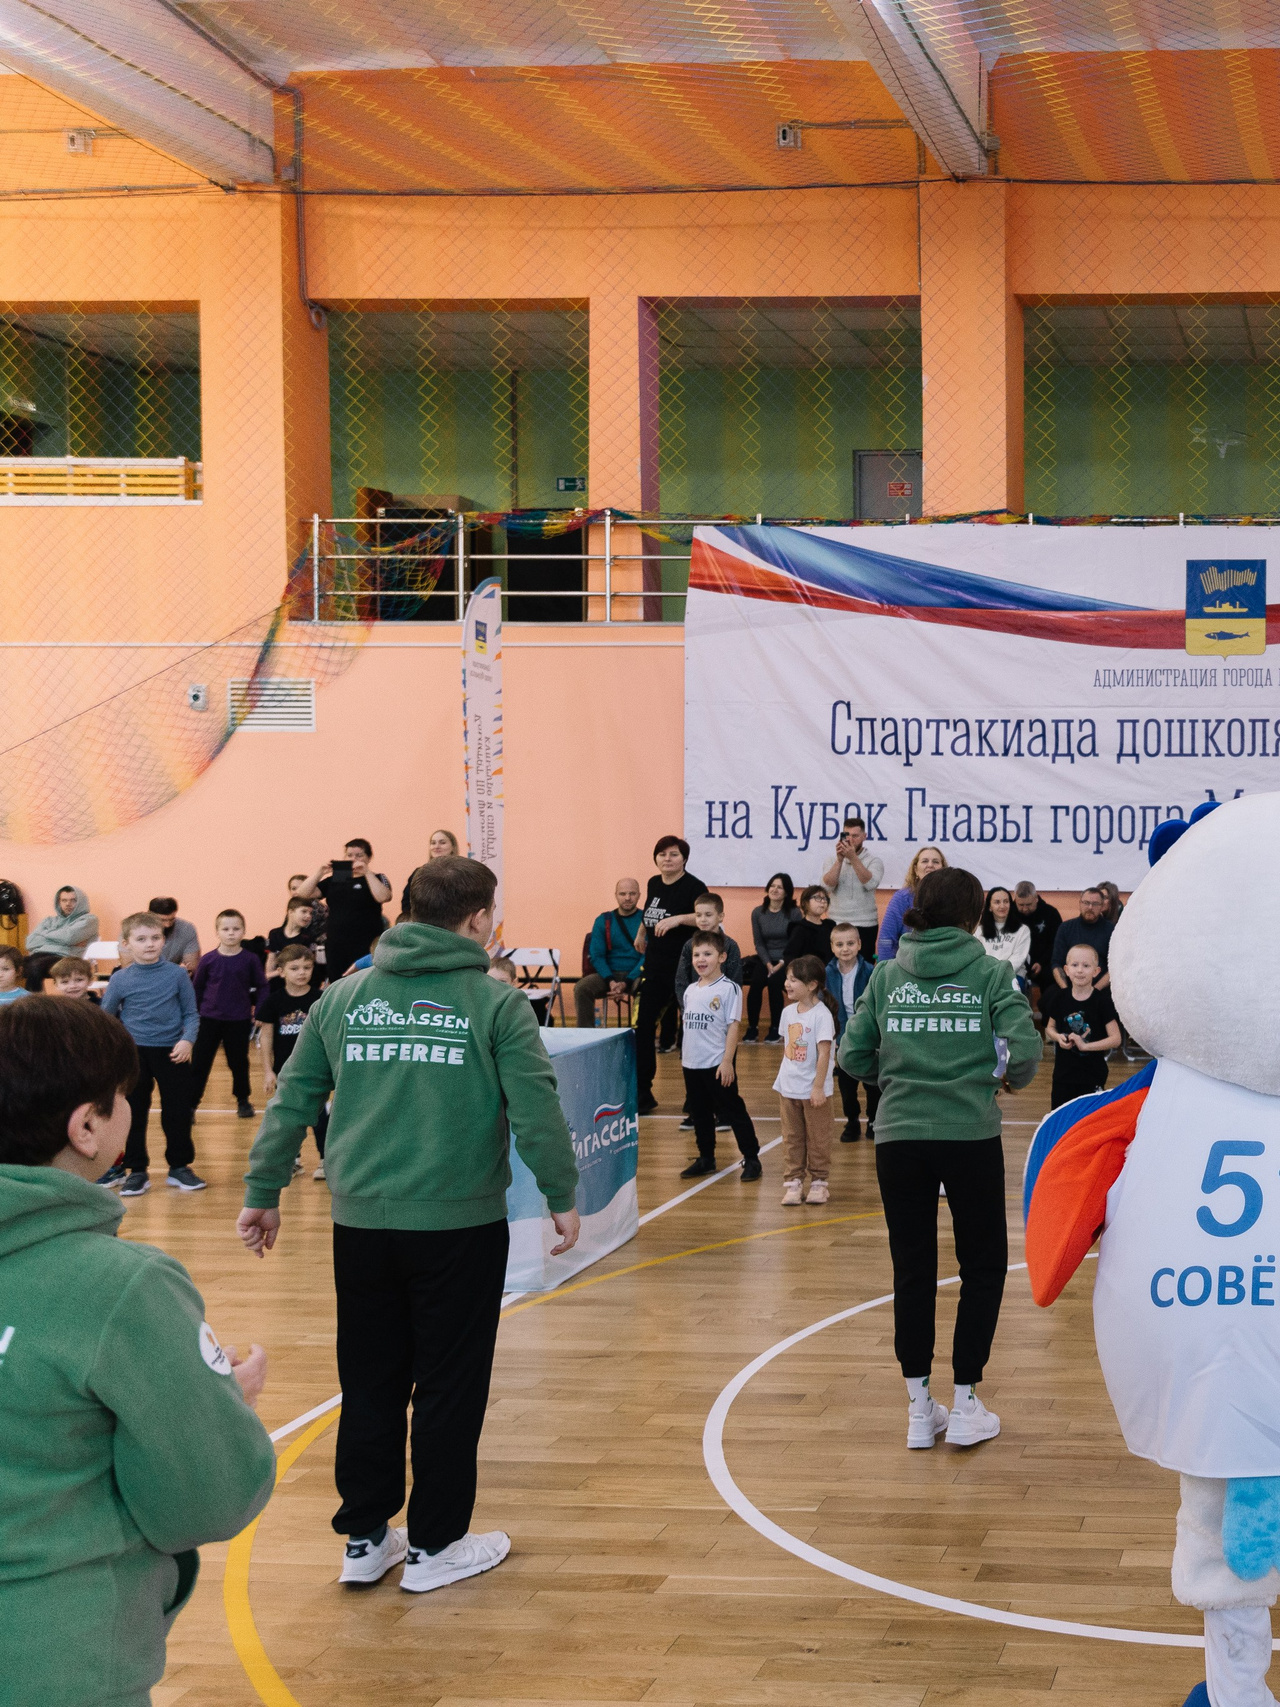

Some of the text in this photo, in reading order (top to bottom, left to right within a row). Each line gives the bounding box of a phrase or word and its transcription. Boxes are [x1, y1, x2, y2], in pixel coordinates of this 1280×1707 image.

[1093, 668, 1218, 689] АДМИНИСТРАЦИЯ
[1223, 668, 1273, 689] ГОРОДА
[830, 700, 1099, 767] Спартакиада
[705, 800, 753, 840] на
[904, 787, 1034, 843] Главы
[887, 991, 982, 1004] YUKIGASSEN
[345, 1010, 470, 1029] YUKIGASSEN
[887, 1017, 981, 1033] REFEREE
[346, 1043, 465, 1065] REFEREE
